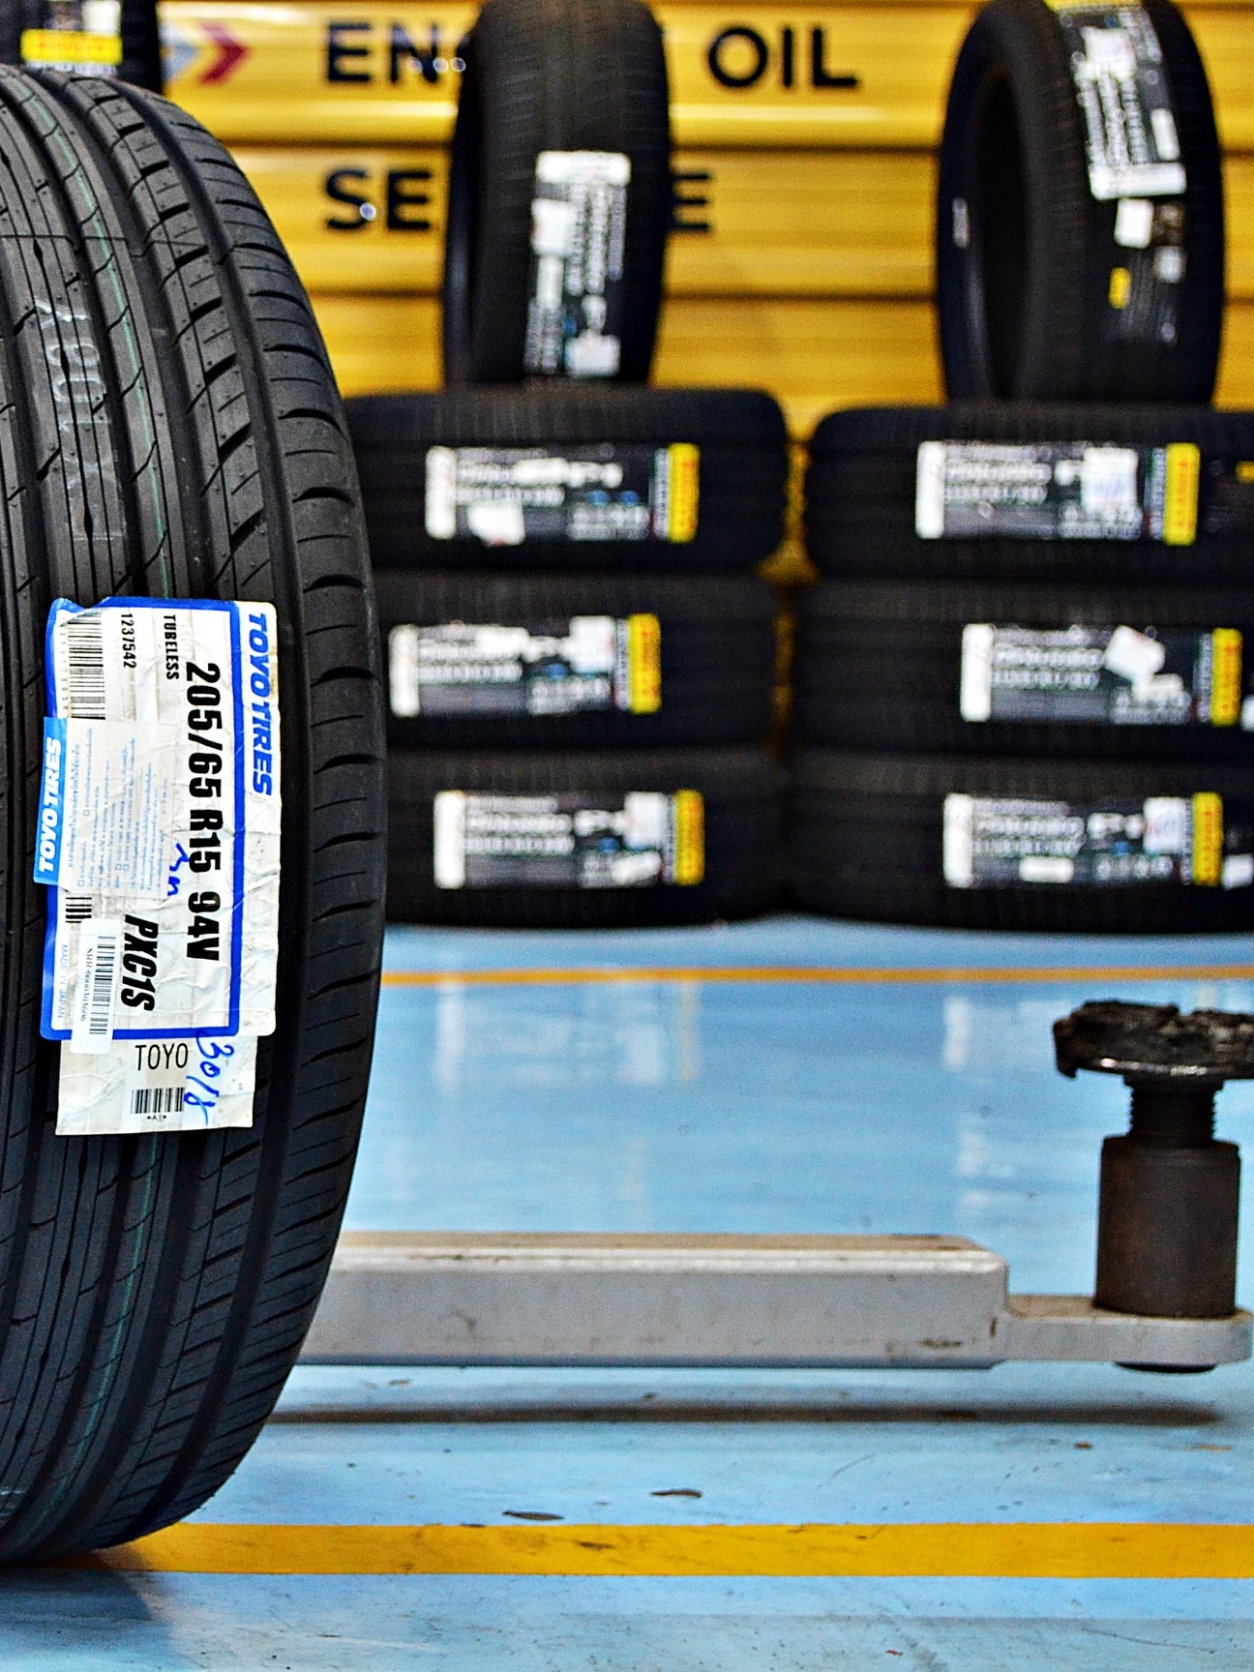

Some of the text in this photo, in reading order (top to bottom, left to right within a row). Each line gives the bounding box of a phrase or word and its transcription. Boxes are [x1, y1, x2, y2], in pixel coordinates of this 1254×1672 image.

[708, 26, 858, 88] OIL
[120, 612, 138, 669] 1237542
[163, 614, 180, 681] TUBELESS
[248, 612, 273, 796] TOYO TIRES
[38, 736, 62, 873] TOYO TIRES
[186, 661, 224, 961] 205/65 R15 94V
[120, 913, 159, 1012] PXC1S
[135, 1042, 189, 1071] TOYO
